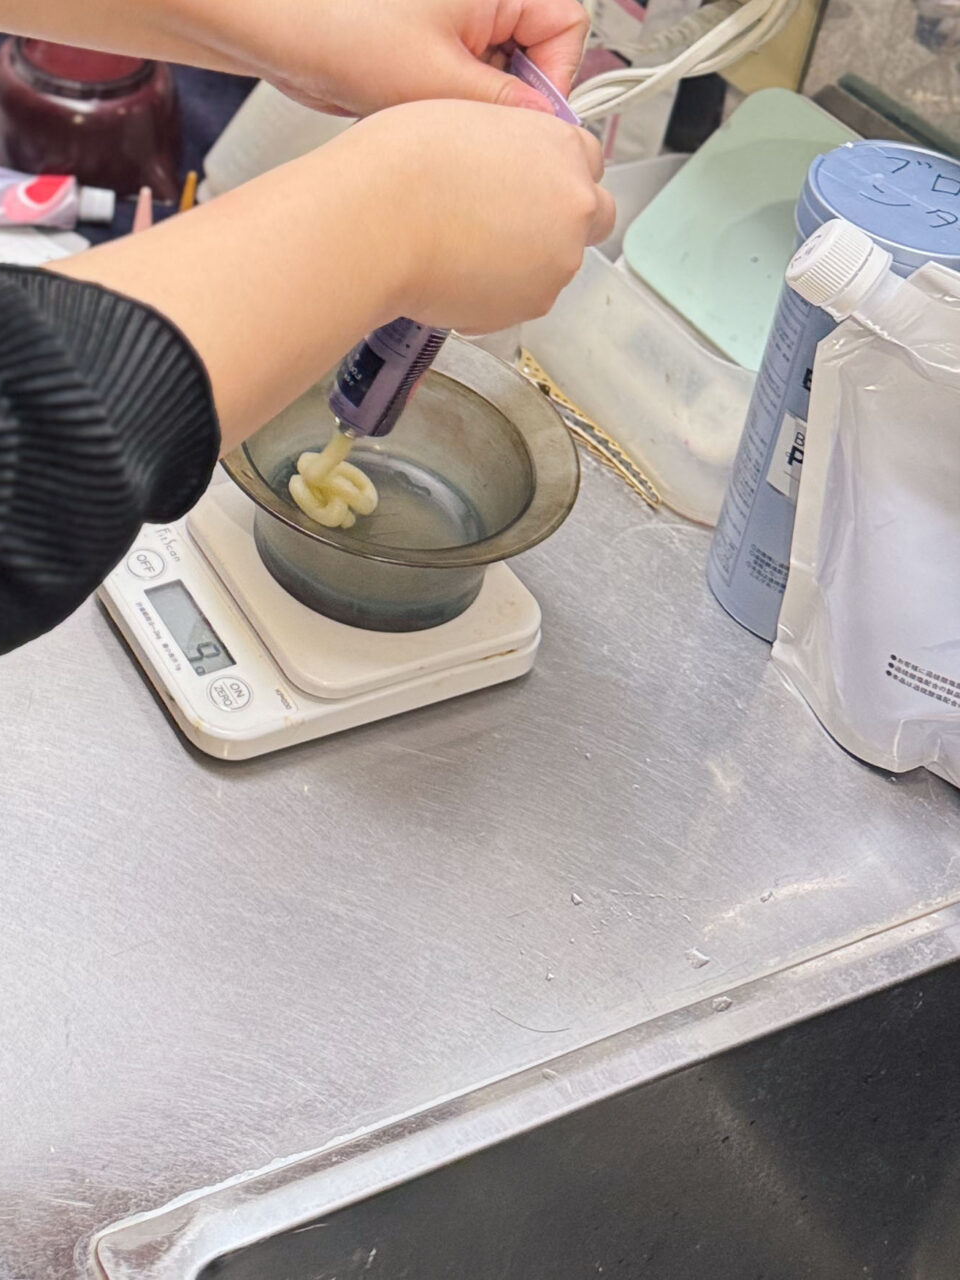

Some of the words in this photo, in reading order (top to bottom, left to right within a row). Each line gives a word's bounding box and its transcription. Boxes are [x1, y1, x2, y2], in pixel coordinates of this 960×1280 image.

[136, 554, 156, 574] OFF
[213, 685, 233, 707] ZERO
[230, 682, 245, 699] ON
